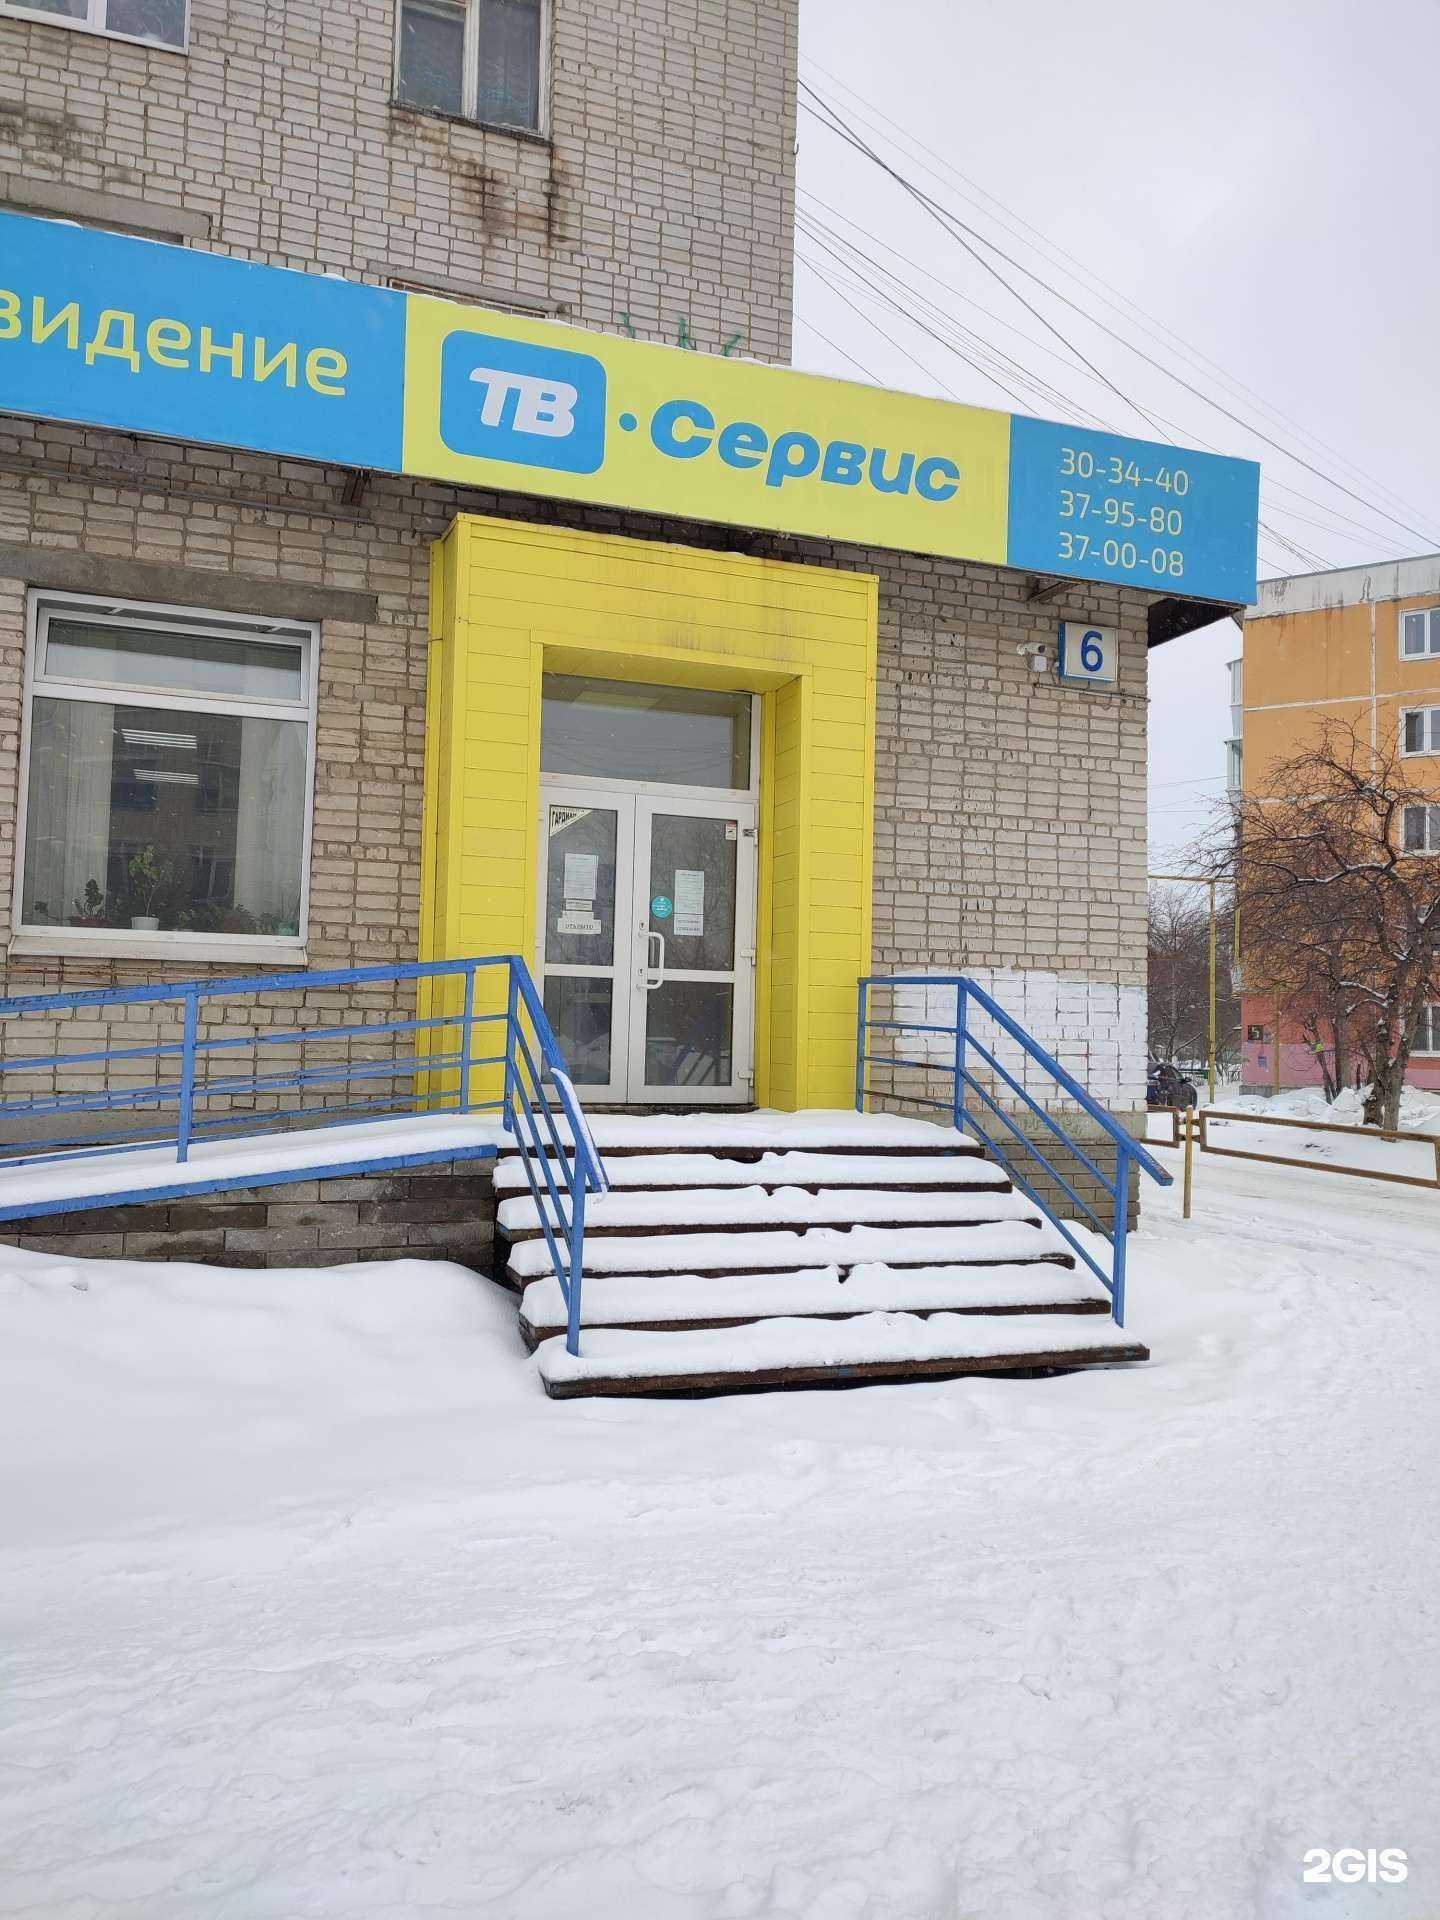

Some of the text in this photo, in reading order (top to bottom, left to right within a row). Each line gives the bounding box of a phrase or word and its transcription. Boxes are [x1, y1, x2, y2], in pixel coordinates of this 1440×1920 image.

[469, 367, 961, 502] ТВ Сервис
[1060, 447, 1189, 497] 30-34-40
[1059, 489, 1183, 536] 37-95-80
[1058, 531, 1184, 577] 37-00-08
[1081, 630, 1103, 672] 6
